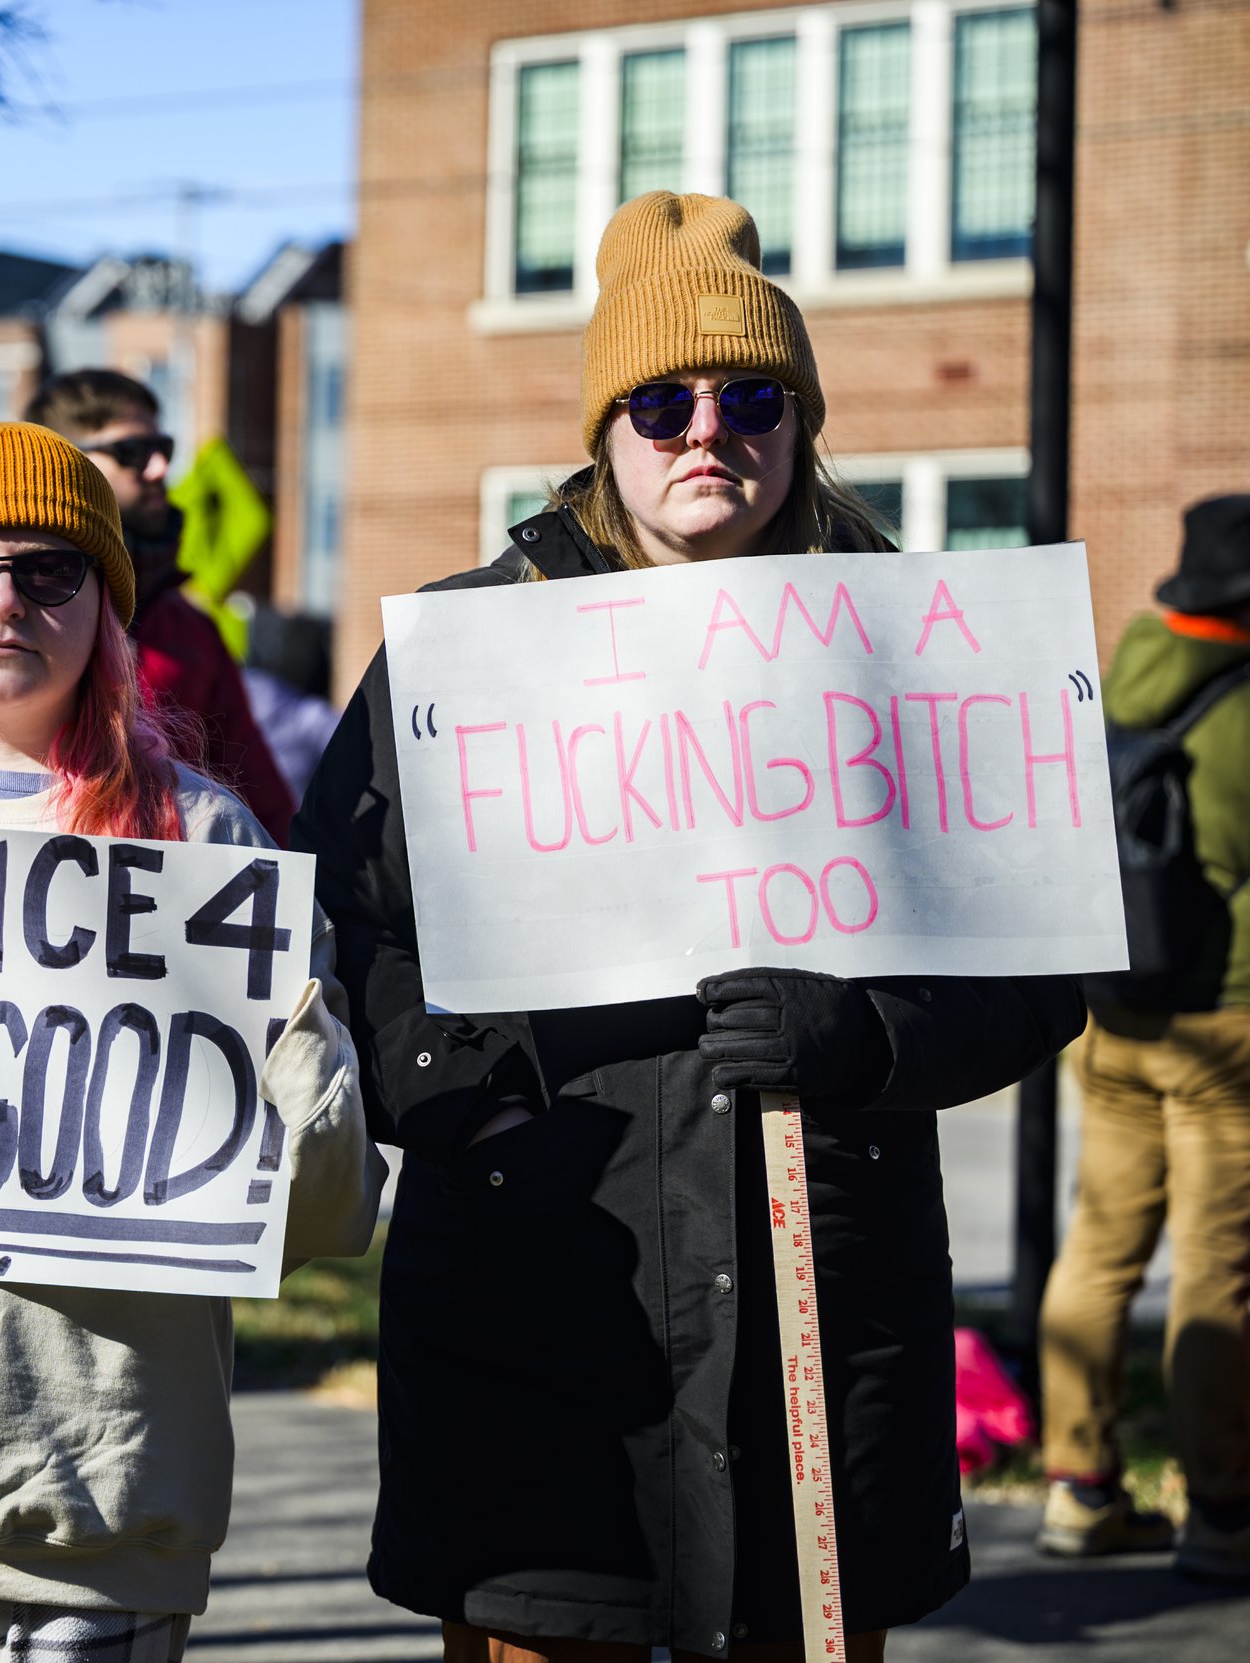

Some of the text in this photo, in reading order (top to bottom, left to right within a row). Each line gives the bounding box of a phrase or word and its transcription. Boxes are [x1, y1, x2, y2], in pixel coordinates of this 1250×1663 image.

[576, 579, 982, 686] I AM A
[696, 855, 879, 949] TOO
[184, 857, 292, 1001] 4
[785, 1134, 795, 1148] 15
[787, 1167, 797, 1181] 16
[770, 1196, 787, 1229] ACE
[790, 1200, 800, 1214] 17
[793, 1233, 803, 1248] 18
[795, 1266, 806, 1281] 19
[798, 1299, 809, 1314] 20
[801, 1332, 811, 1347] 21
[804, 1366, 814, 1381] 22
[806, 1400, 817, 1415] 23
[787, 1355, 806, 1485] The helpful place.
[809, 1433, 819, 1448] 24
[812, 1467, 822, 1482] 25
[814, 1501, 826, 1516] 26
[817, 1535, 828, 1550] 27
[820, 1569, 831, 1585] 28
[823, 1604, 833, 1619] 29
[825, 1638, 835, 1653] 30
